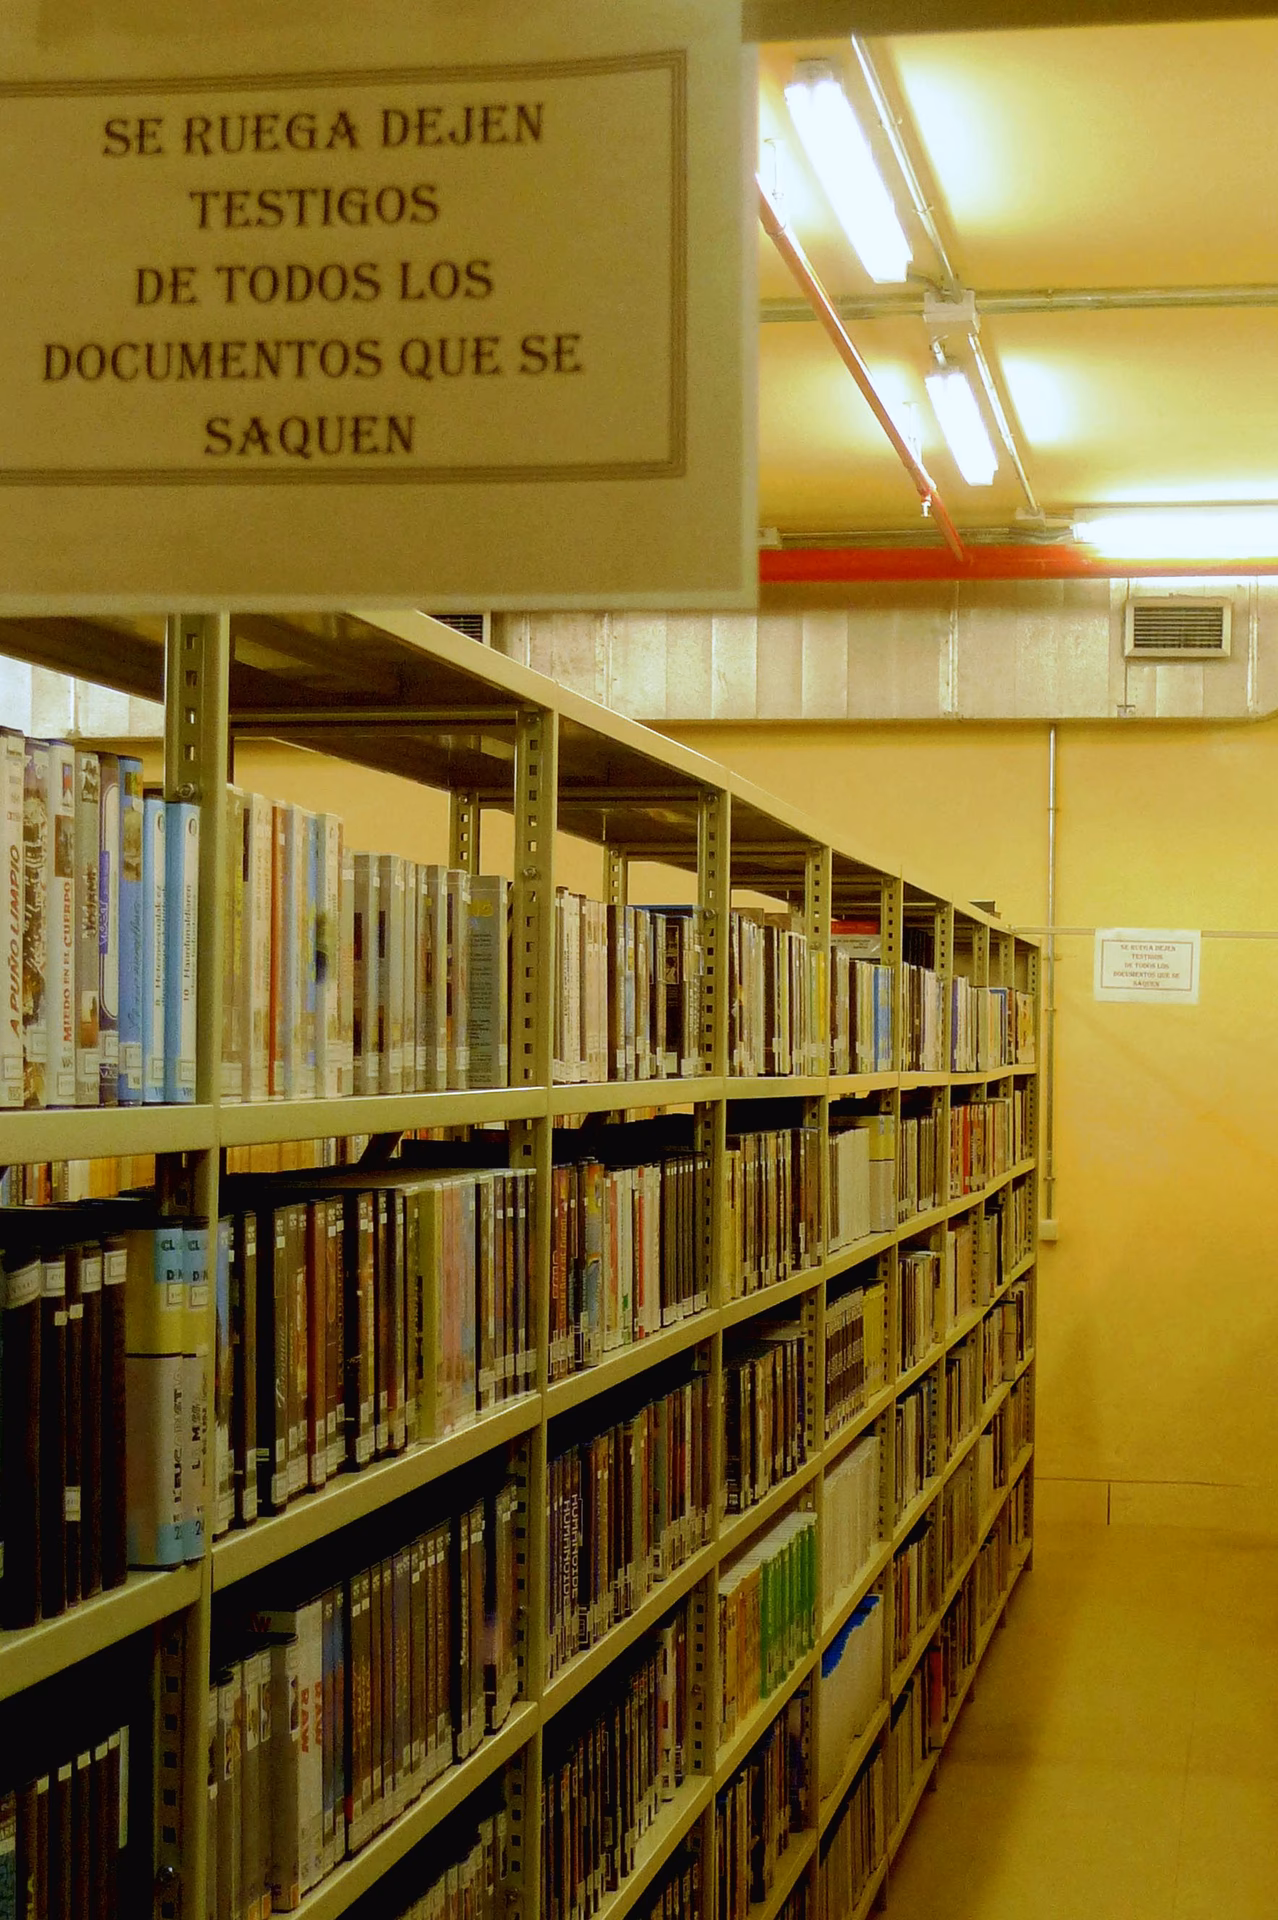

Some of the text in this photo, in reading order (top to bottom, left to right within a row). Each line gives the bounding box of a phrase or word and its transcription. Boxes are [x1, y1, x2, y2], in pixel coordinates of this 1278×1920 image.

[102, 103, 544, 157] SE RUEGA DEJEN
[188, 183, 440, 230] TESTIGOS
[135, 259, 494, 306] DE TODOS LOS
[42, 333, 583, 382] DOCUMENTOS QUE SE
[203, 414, 415, 460] SAQUEN
[7, 844, 21, 1040] A PUÑO LIMPIO
[63, 882, 73, 947] CUERPO
[63, 987, 72, 1043] MIEDO
[563, 1500, 571, 1607] HUMANOIDE
[571, 1493, 579, 1599] HUMANOIDE
